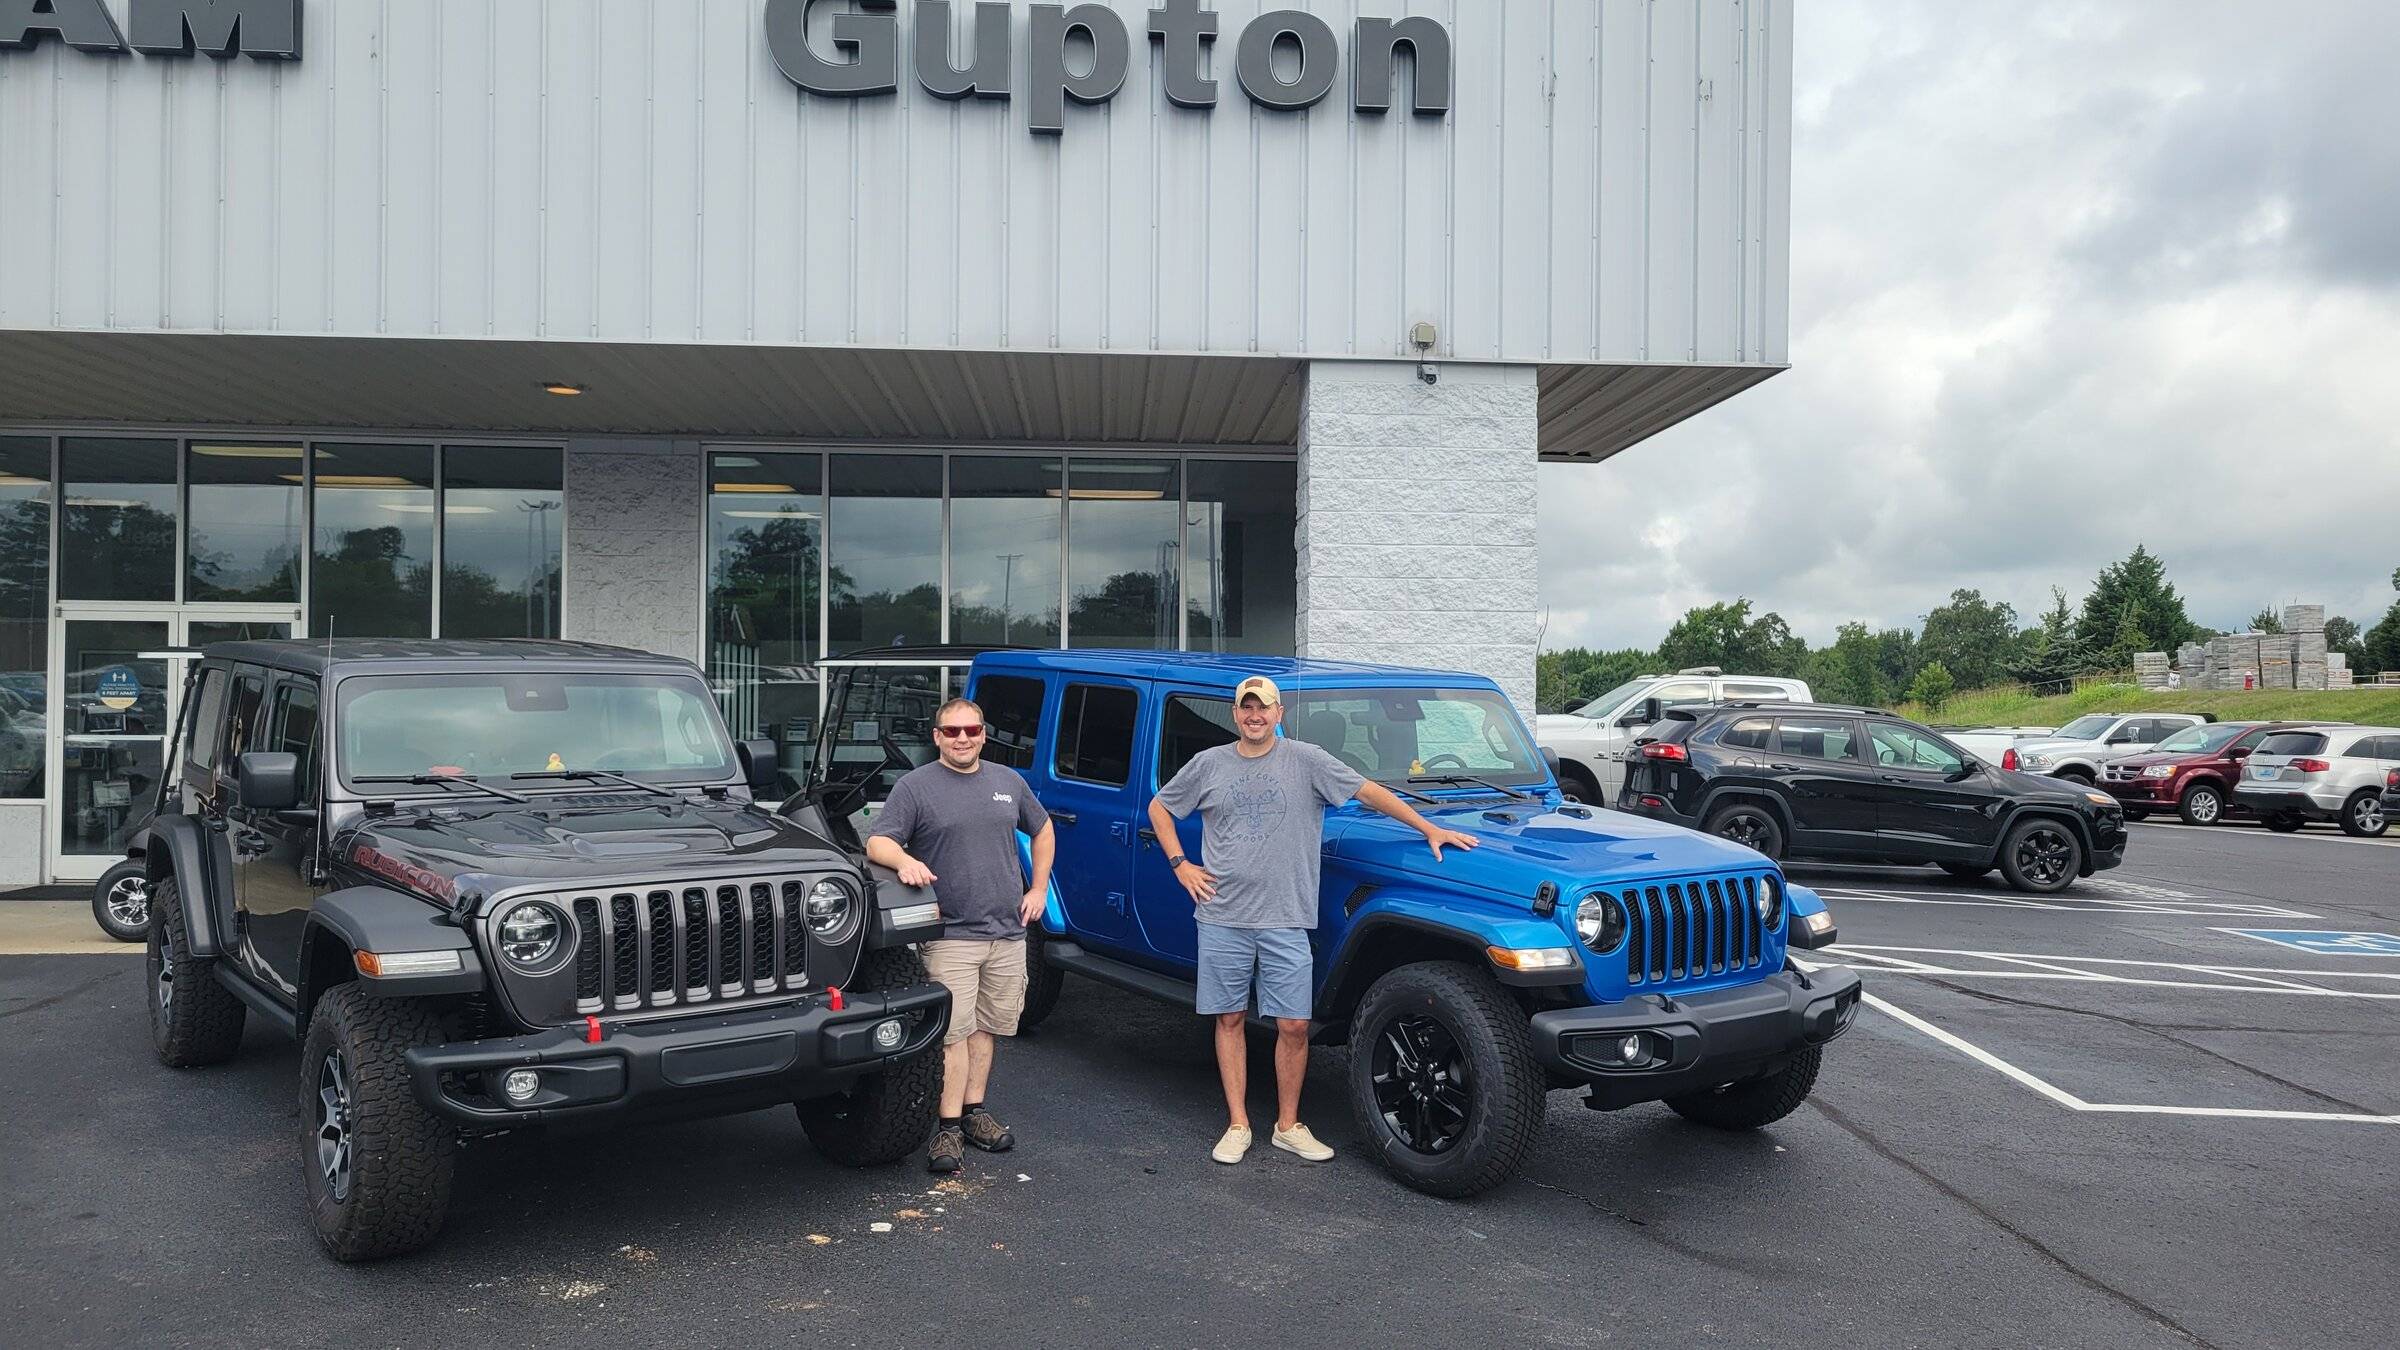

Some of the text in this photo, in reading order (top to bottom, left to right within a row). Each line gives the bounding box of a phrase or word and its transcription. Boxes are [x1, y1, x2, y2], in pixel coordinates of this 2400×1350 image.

[764, 0, 1453, 135] Gupton
[1596, 722, 1606, 730] 19
[992, 791, 1013, 804] Jeep
[354, 845, 458, 906] RUBICON
